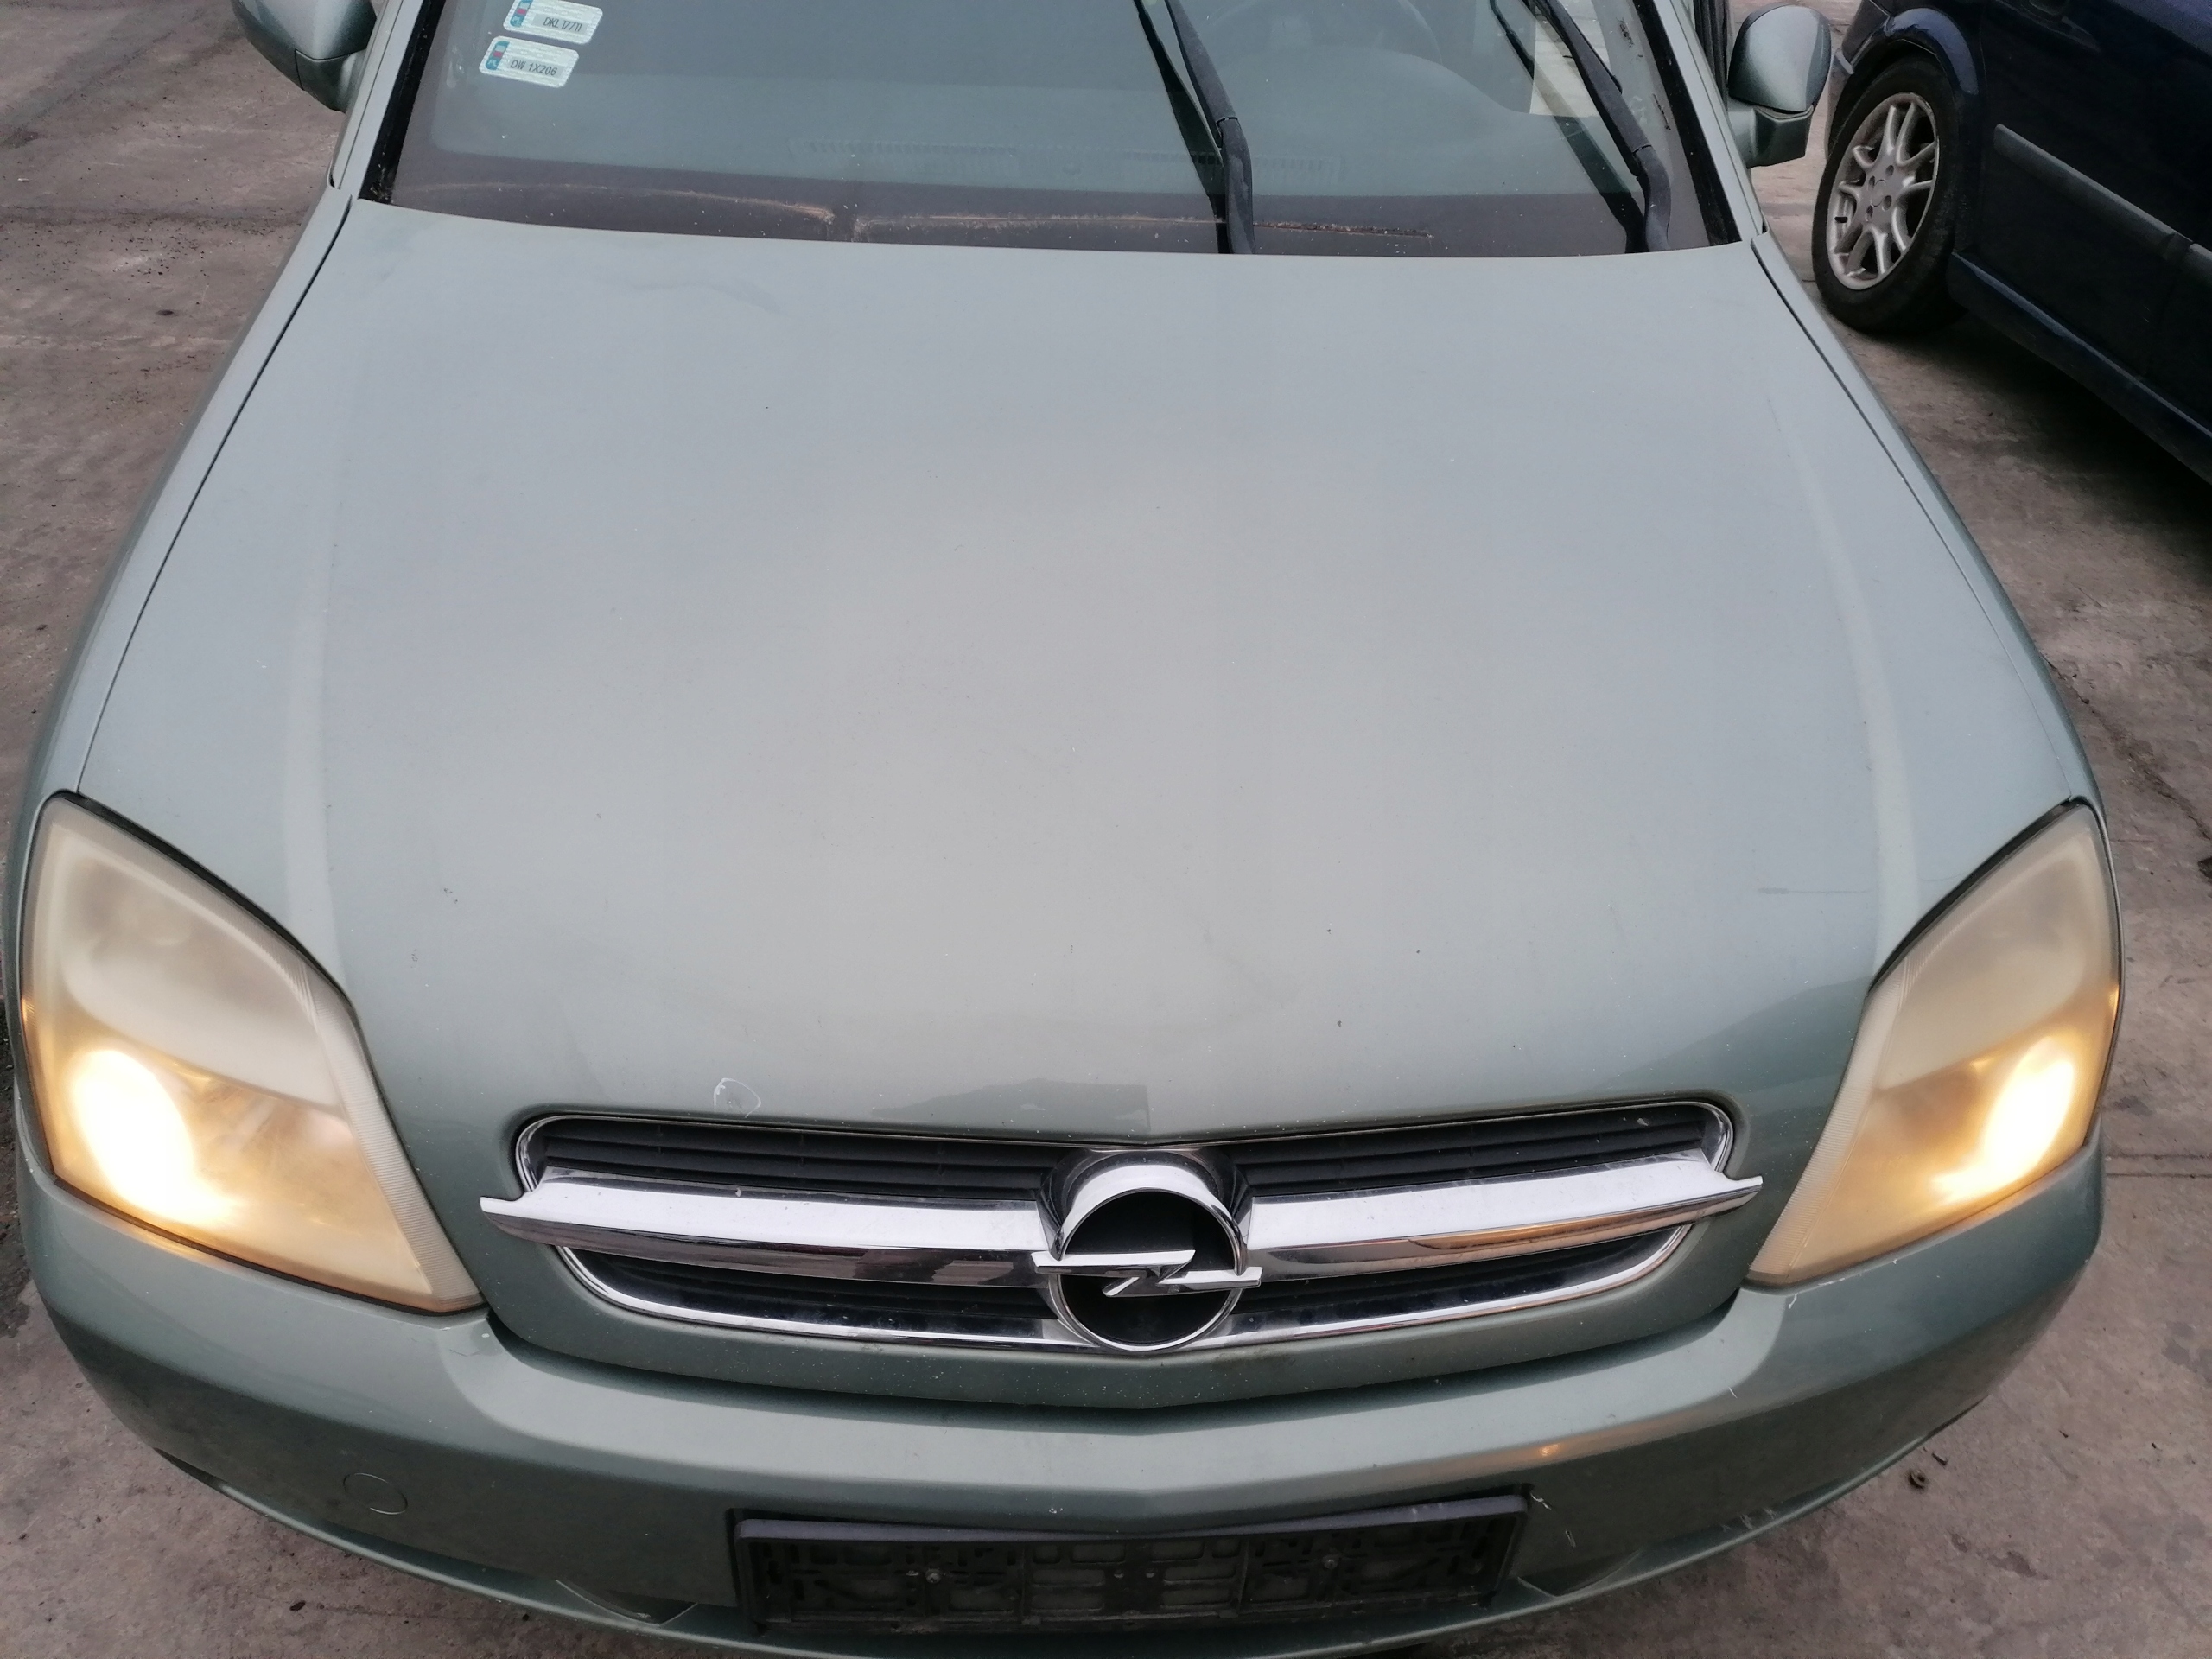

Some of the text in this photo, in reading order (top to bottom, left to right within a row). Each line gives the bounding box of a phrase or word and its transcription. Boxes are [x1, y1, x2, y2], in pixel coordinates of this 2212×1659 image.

[543, 16, 559, 29] DKL
[510, 59, 558, 76] DW 1X206
